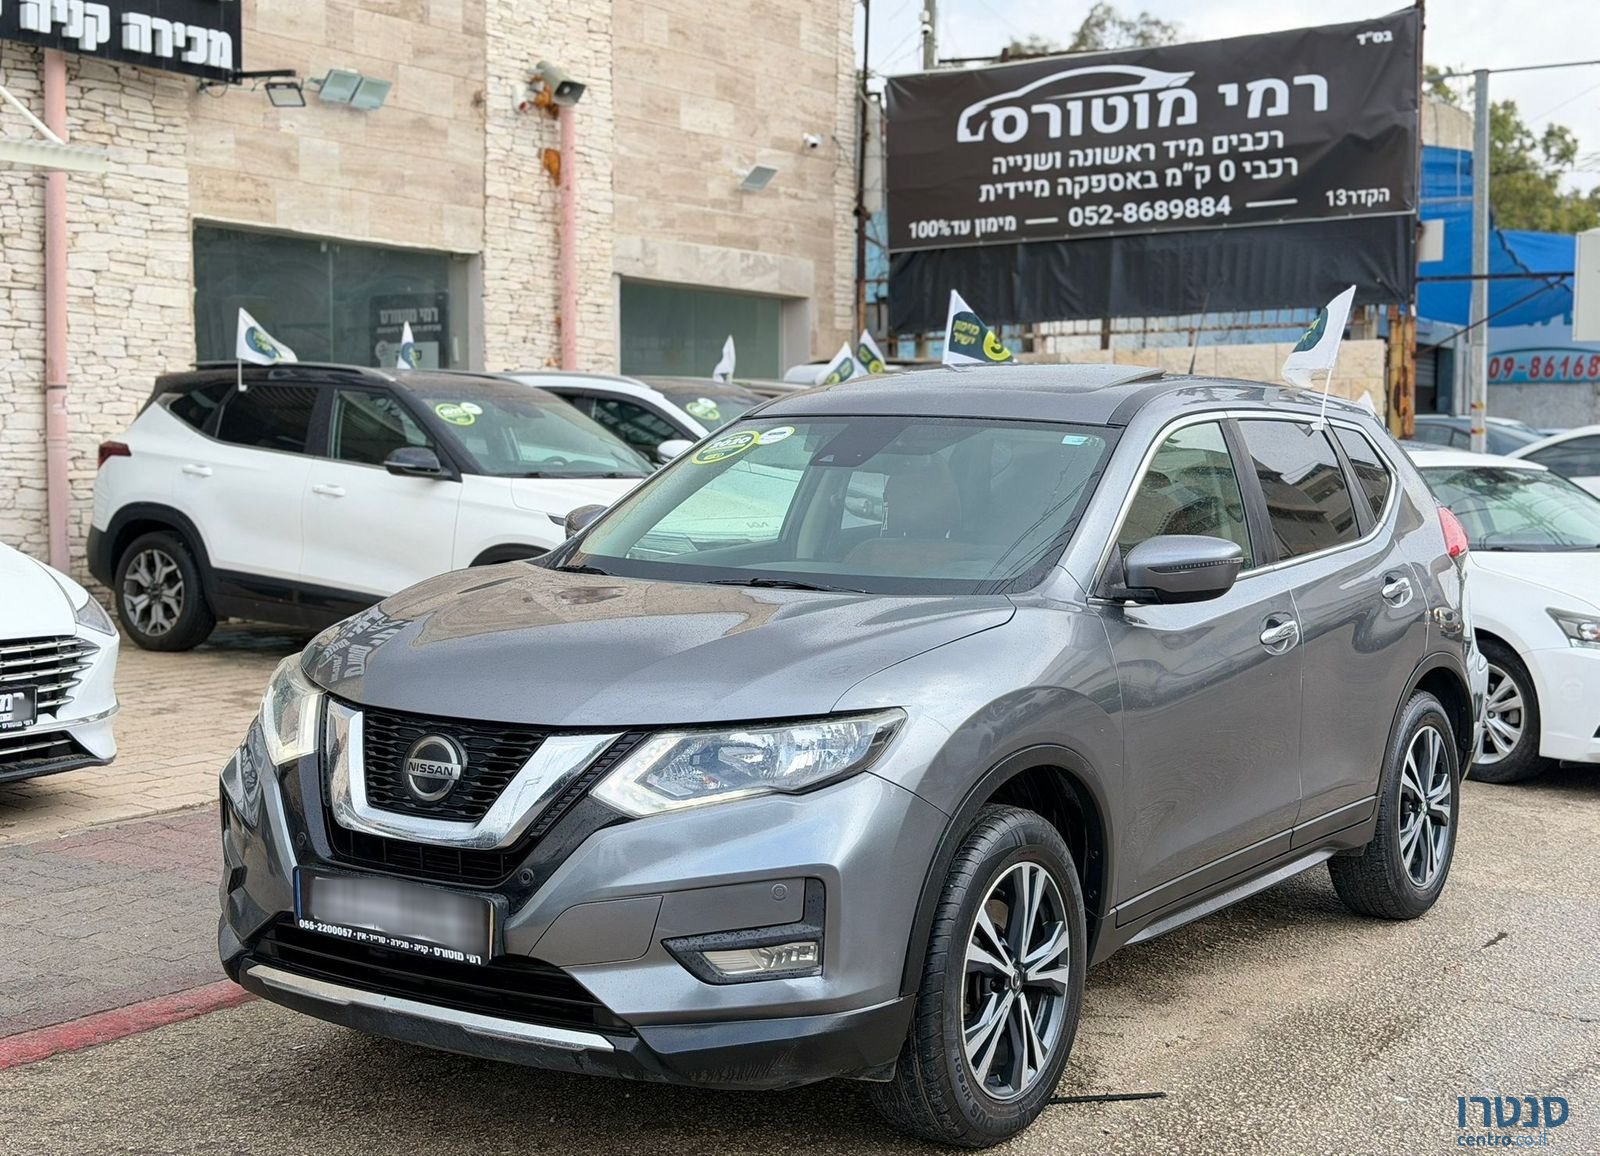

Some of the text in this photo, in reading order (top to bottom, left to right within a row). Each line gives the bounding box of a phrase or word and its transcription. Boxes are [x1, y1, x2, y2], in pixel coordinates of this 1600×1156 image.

[19, 0, 233, 70] מכירה קניה
[1357, 30, 1393, 46] בס"ד
[990, 73, 1328, 144] רמי מוטורס
[991, 130, 1284, 175] רכבים מיד ראשונה ושנייה
[978, 157, 1298, 203] רכבי 0 ק"מ באספקה מיידית
[1068, 195, 1232, 227] 052-8689884
[974, 215, 1017, 238] מימון
[1489, 354, 1600, 379] 09-86168
[408, 761, 453, 776] NISSAN
[299, 919, 352, 938] 055-2200057
[390, 938, 409, 949] מכירה
[414, 943, 428, 955] קניה
[433, 946, 464, 962] מוטורס
[466, 954, 481, 965] רמי
